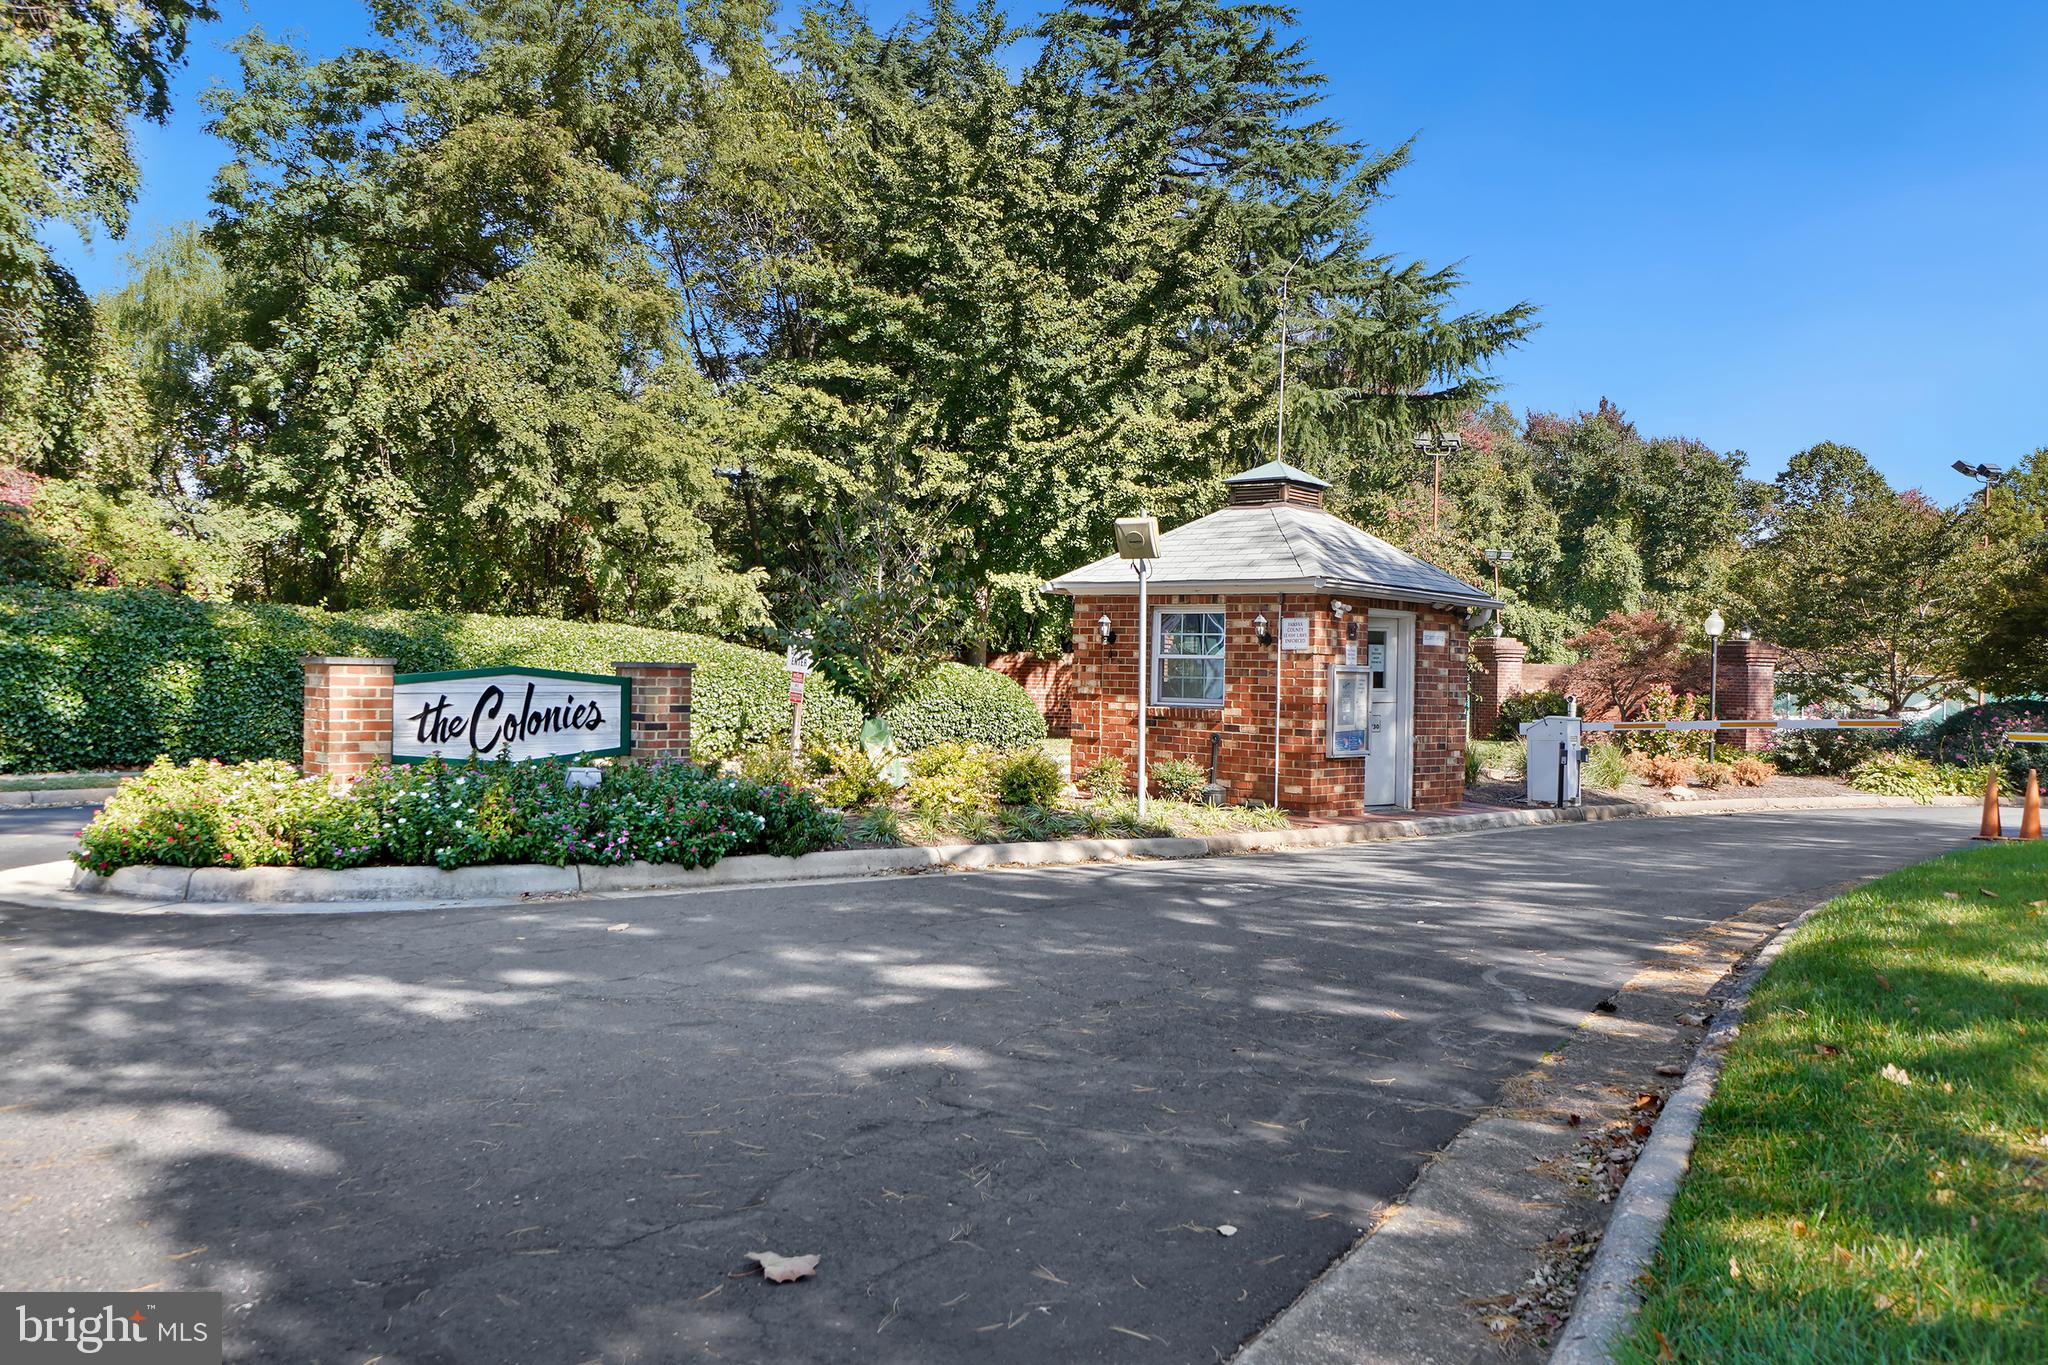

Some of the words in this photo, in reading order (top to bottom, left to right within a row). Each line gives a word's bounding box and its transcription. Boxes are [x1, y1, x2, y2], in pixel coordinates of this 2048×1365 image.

[791, 656, 807, 666] ENTER
[408, 694, 469, 744] the
[469, 682, 606, 753] Colonies
